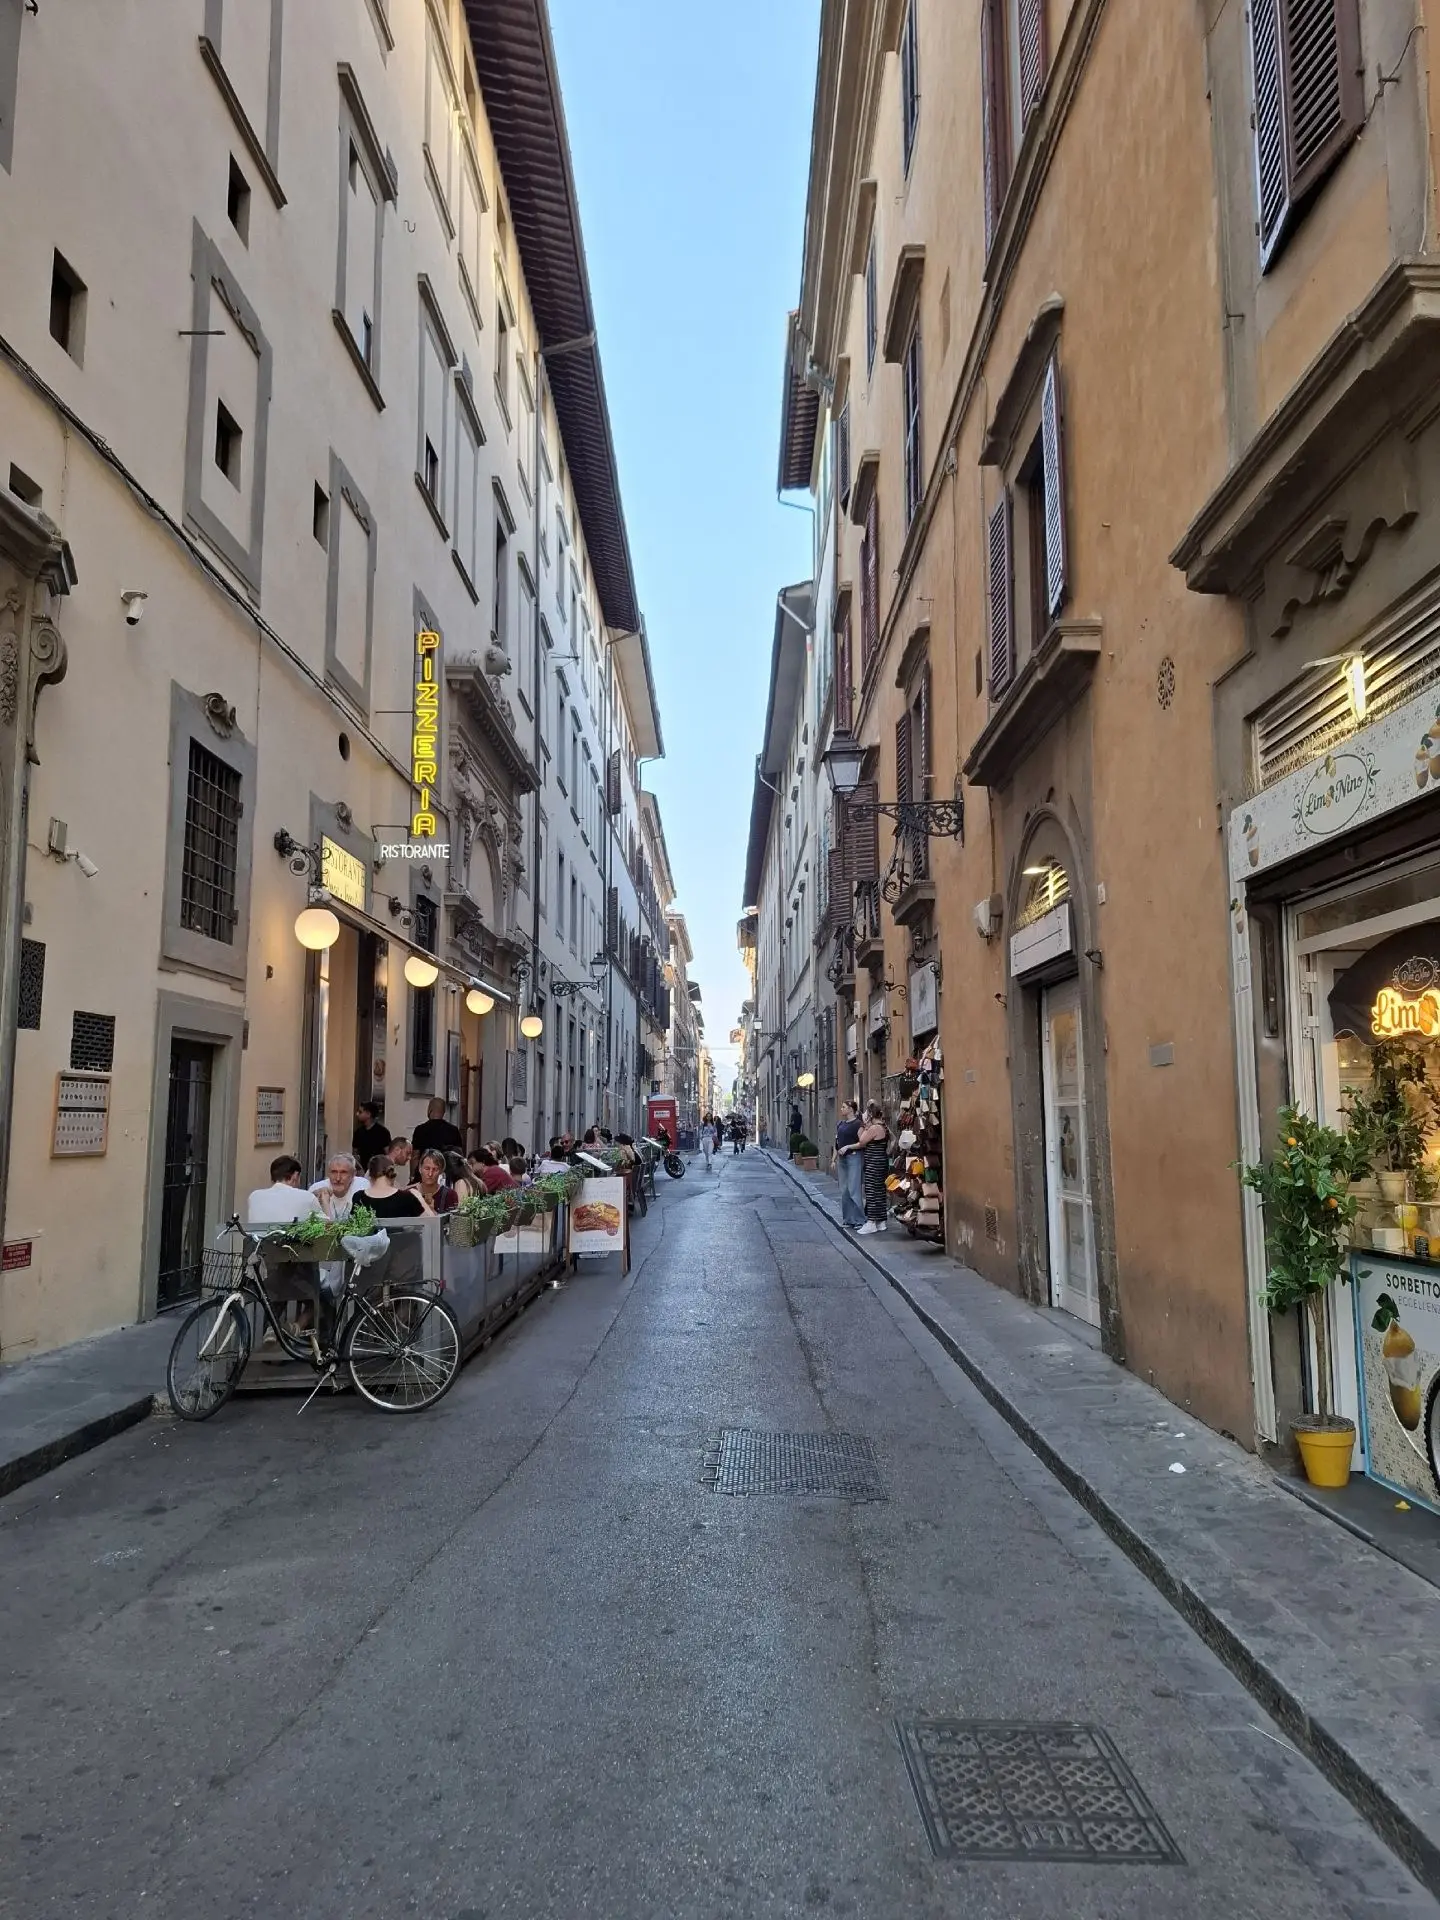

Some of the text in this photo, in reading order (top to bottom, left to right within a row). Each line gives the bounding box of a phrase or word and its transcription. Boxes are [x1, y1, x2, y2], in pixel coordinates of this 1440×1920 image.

[413, 631, 440, 837] PIZZERIA
[1335, 774, 1363, 803] Nino
[381, 844, 450, 859] RISTORANTE
[1386, 1273, 1440, 1299] SORBETTO
